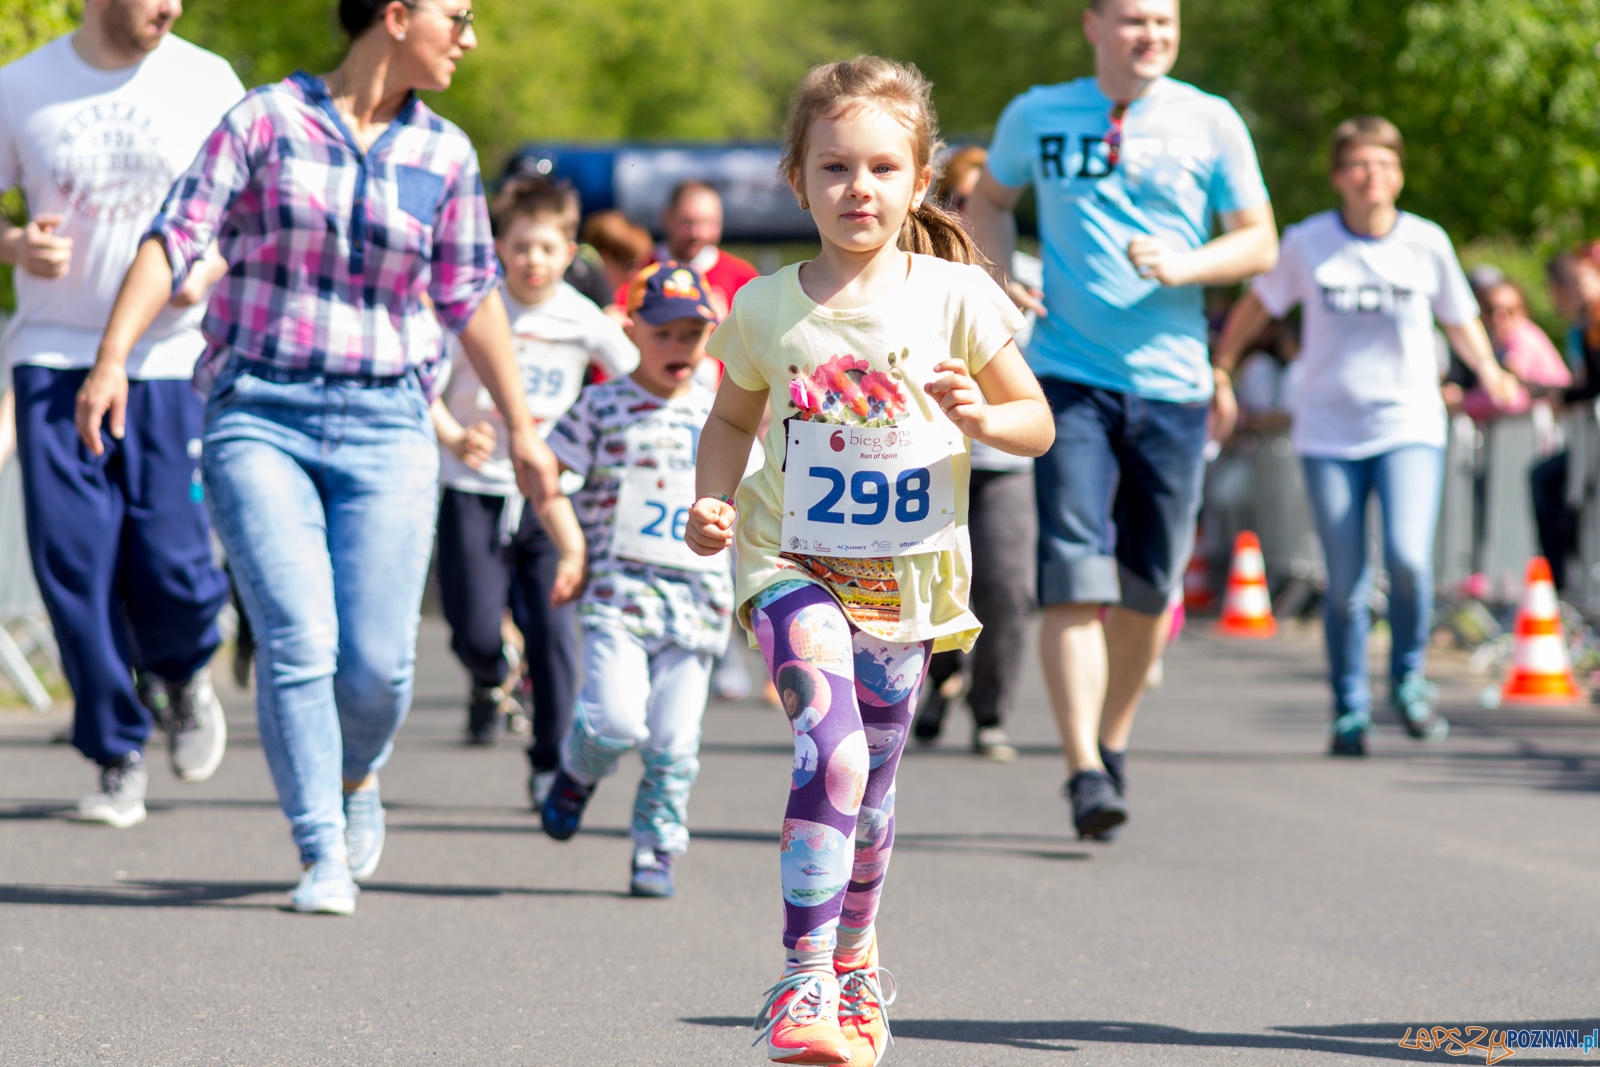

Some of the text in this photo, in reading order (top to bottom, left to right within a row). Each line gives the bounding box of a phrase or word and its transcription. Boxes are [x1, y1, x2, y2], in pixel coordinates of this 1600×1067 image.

[829, 429, 883, 452] 6 bieg
[881, 453, 898, 461] Spirit
[807, 466, 931, 525] 298
